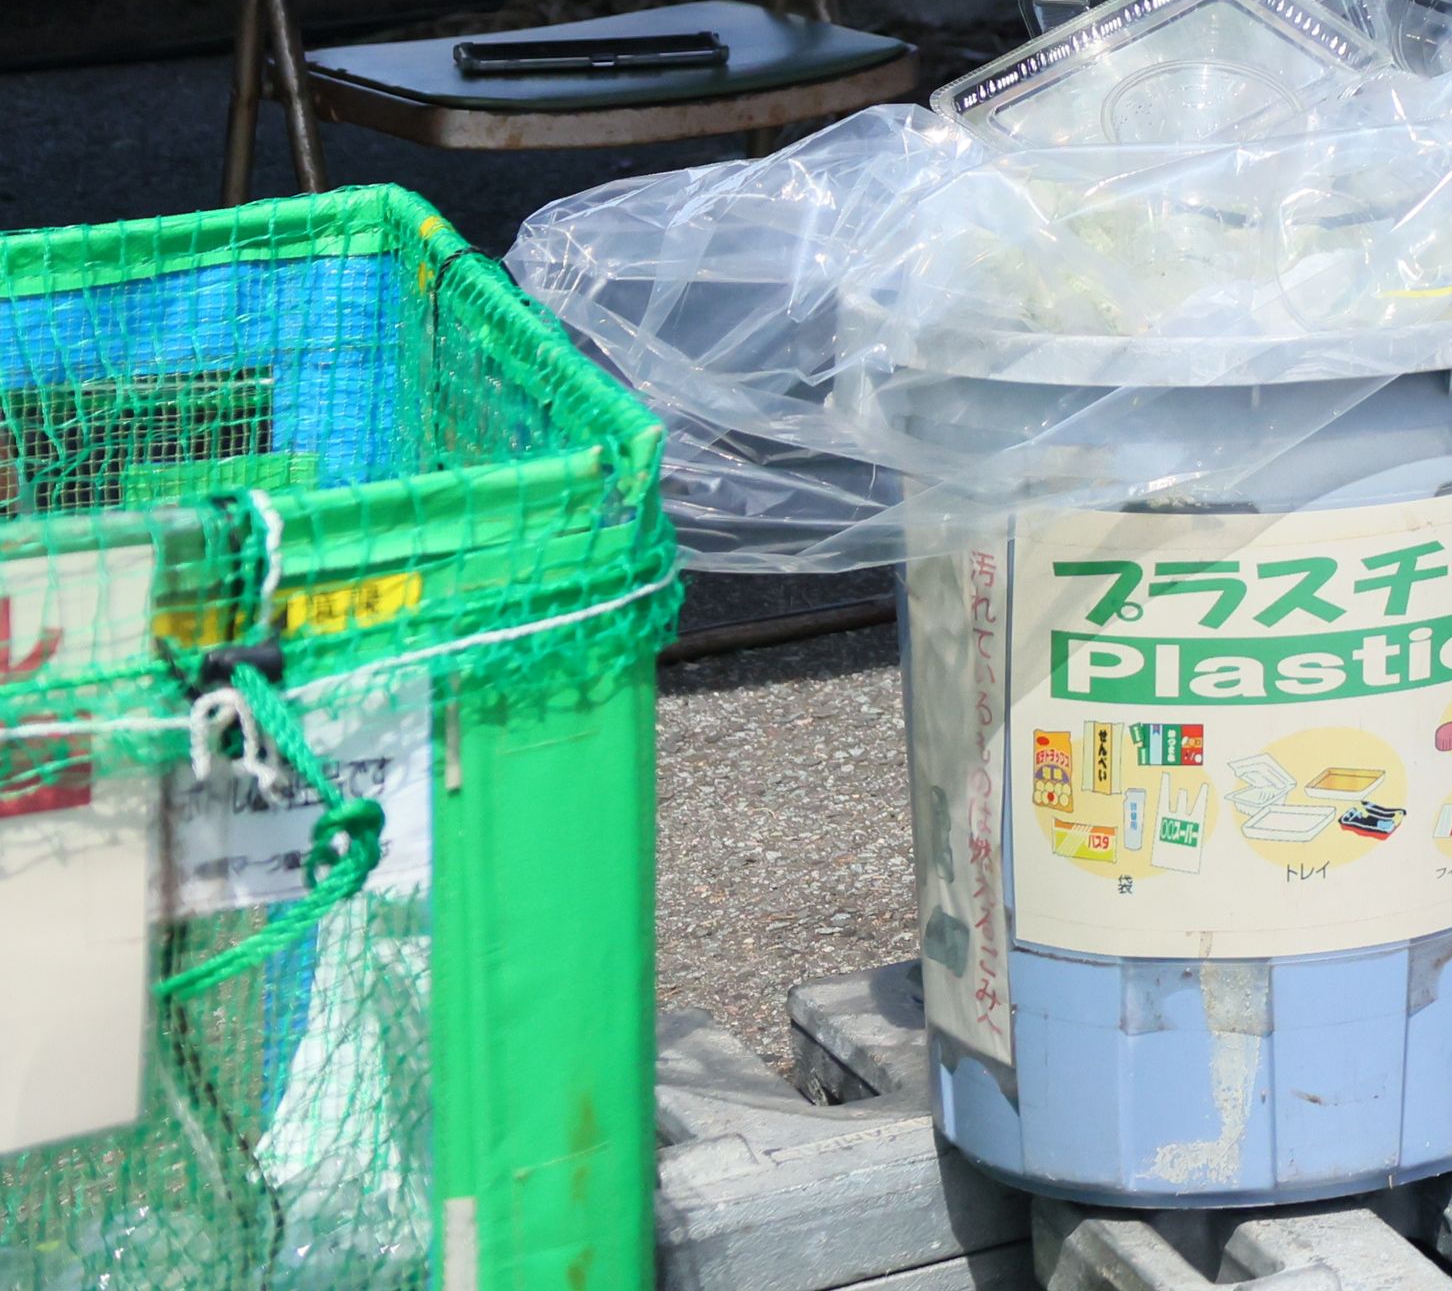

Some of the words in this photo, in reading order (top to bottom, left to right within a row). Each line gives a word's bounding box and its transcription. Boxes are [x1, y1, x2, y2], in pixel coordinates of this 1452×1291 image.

[1098, 729, 1108, 782] せんべい
[1088, 835, 1109, 849] パスタ
[1285, 859, 1331, 883] トレイ
[1118, 875, 1133, 894] 袋
